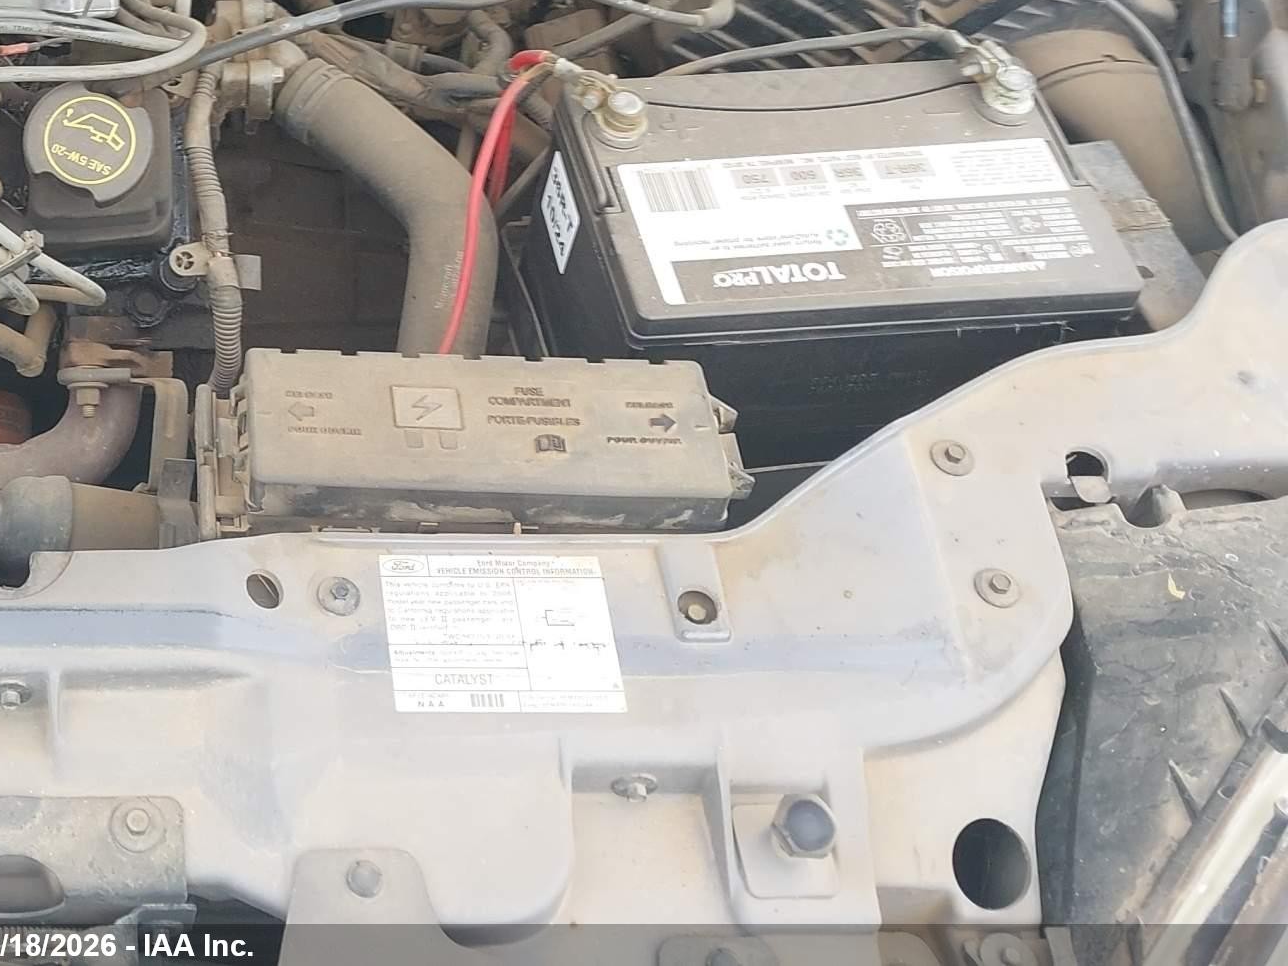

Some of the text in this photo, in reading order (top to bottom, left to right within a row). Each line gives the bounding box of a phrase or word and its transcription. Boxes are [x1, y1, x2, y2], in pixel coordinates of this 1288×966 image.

[51, 143, 112, 176] SAE 5W-20
[713, 262, 846, 288] TOTALPRO
[513, 386, 544, 397] FUSE
[488, 396, 571, 408] COMPARTMENT
[392, 559, 416, 572] Ford
[468, 568, 505, 576] EMISSION
[507, 568, 541, 576] CONTROL
[434, 673, 493, 685] CATALYST
